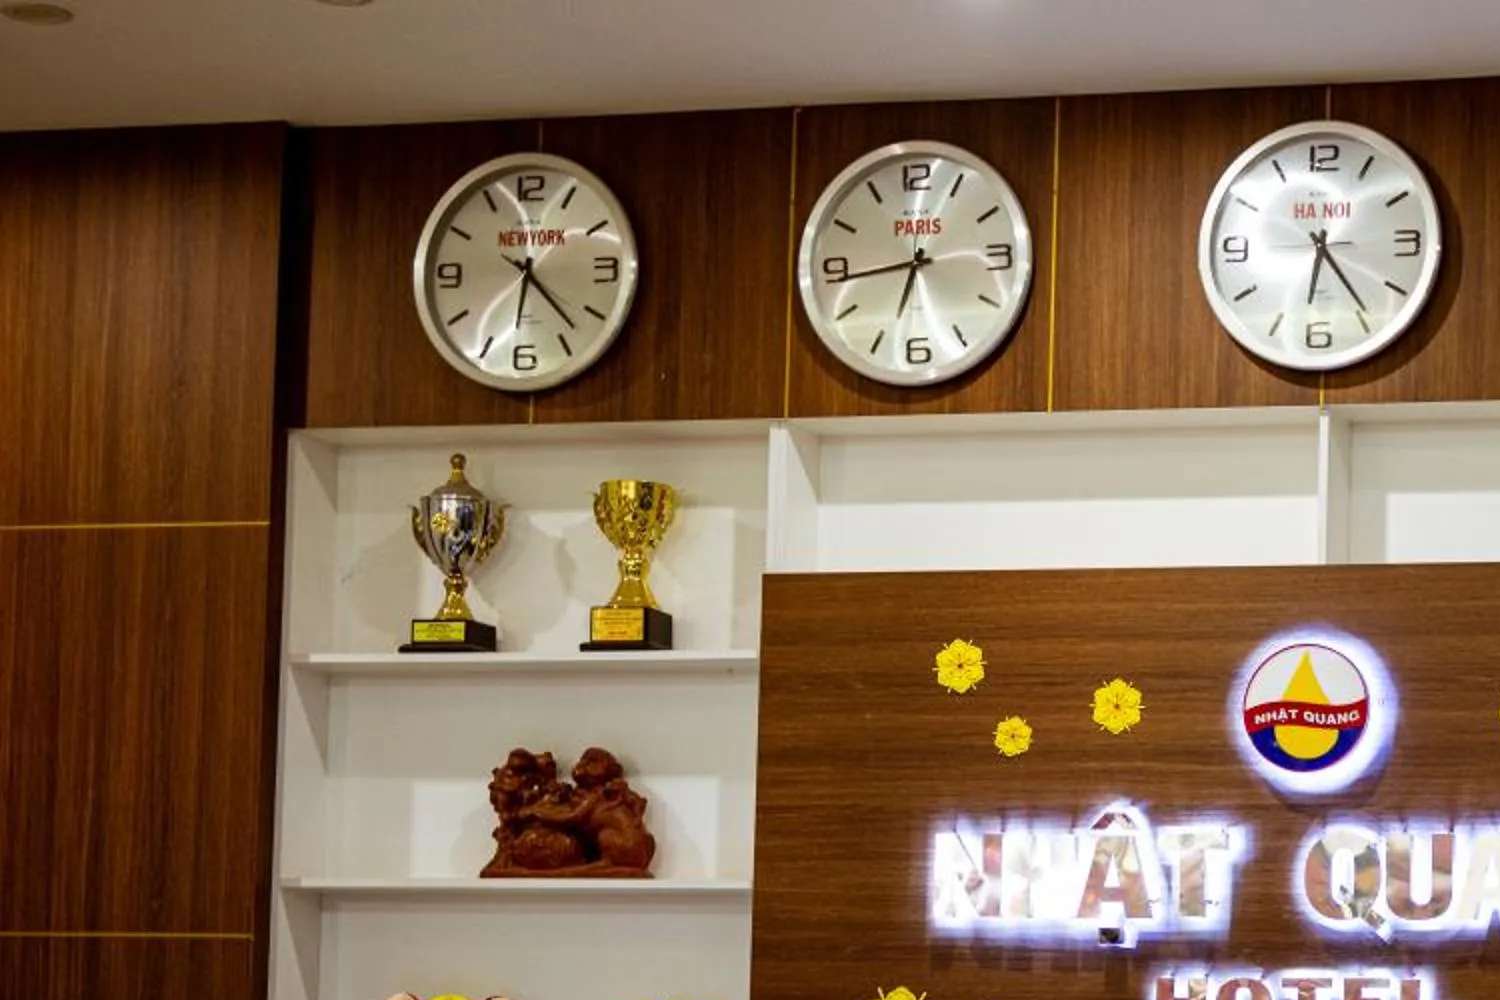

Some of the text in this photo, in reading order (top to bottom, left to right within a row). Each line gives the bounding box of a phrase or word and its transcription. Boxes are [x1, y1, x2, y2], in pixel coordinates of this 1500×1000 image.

[1309, 145, 1340, 172] 12
[518, 176, 545, 201] 12
[903, 164, 931, 192] 12
[1293, 202, 1351, 219] HA NOI
[894, 217, 941, 236] PARIS
[1223, 237, 1249, 263] 9
[1394, 229, 1421, 257] 3
[593, 257, 619, 283] 3
[823, 257, 849, 284] 9
[986, 244, 1013, 271] 3
[437, 263, 462, 289] 9
[1306, 321, 1332, 349] 6
[513, 345, 537, 371] 6
[906, 337, 932, 364] 6
[1303, 710, 1360, 725] QUANG
